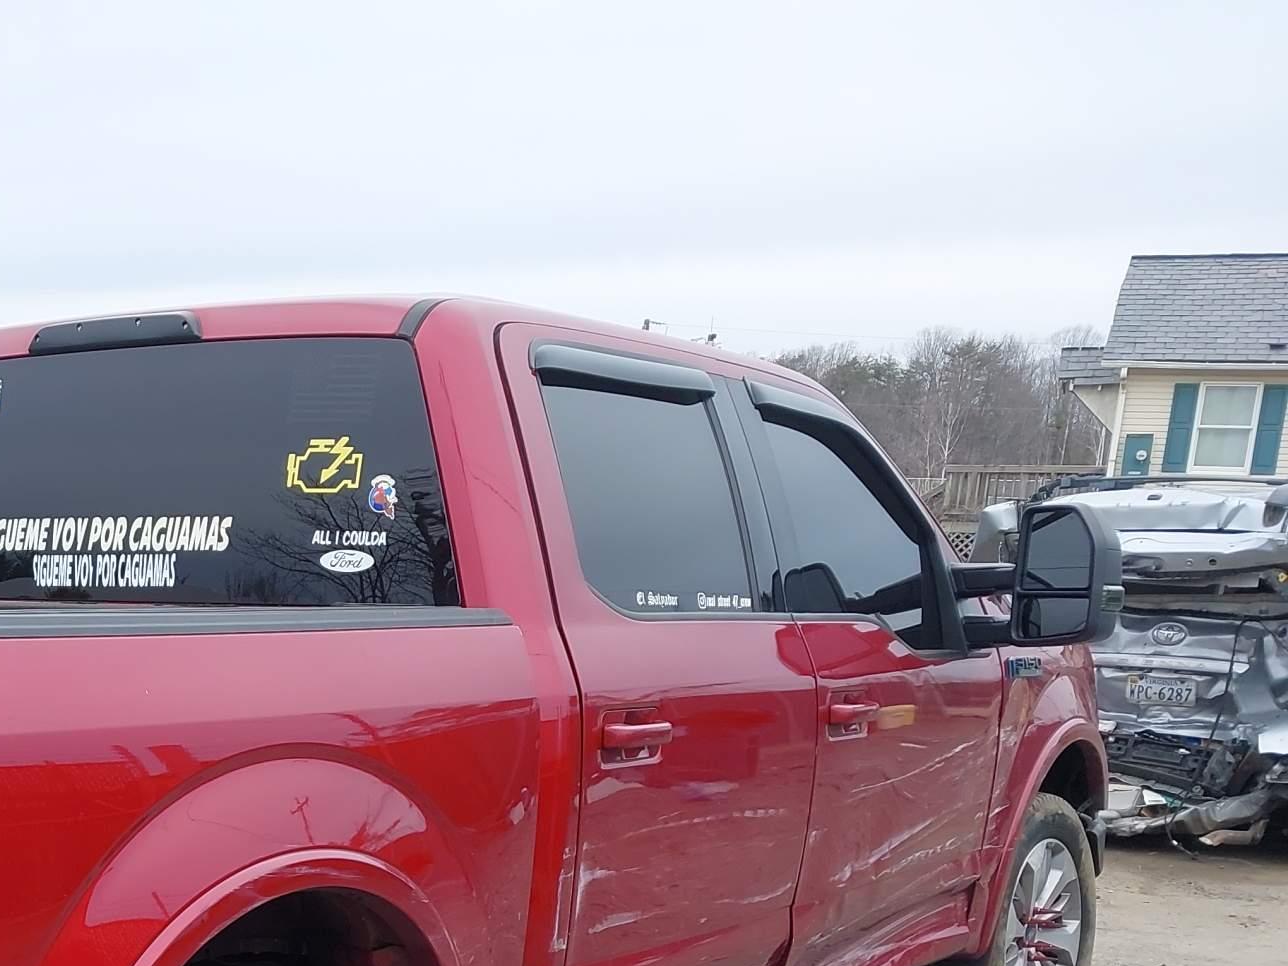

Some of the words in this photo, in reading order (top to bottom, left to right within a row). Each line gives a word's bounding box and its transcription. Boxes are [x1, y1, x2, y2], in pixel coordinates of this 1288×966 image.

[52, 516, 89, 552] VOY
[88, 516, 127, 552] POR
[129, 515, 233, 552] CAGUAMAS
[312, 530, 332, 545] ALL
[335, 531, 340, 545] I
[342, 530, 387, 546] COULDA
[329, 551, 364, 569] Ford
[95, 553, 117, 588] POR
[118, 552, 177, 588] CAGUAMAS
[1129, 683, 1192, 702] WPC-6287
